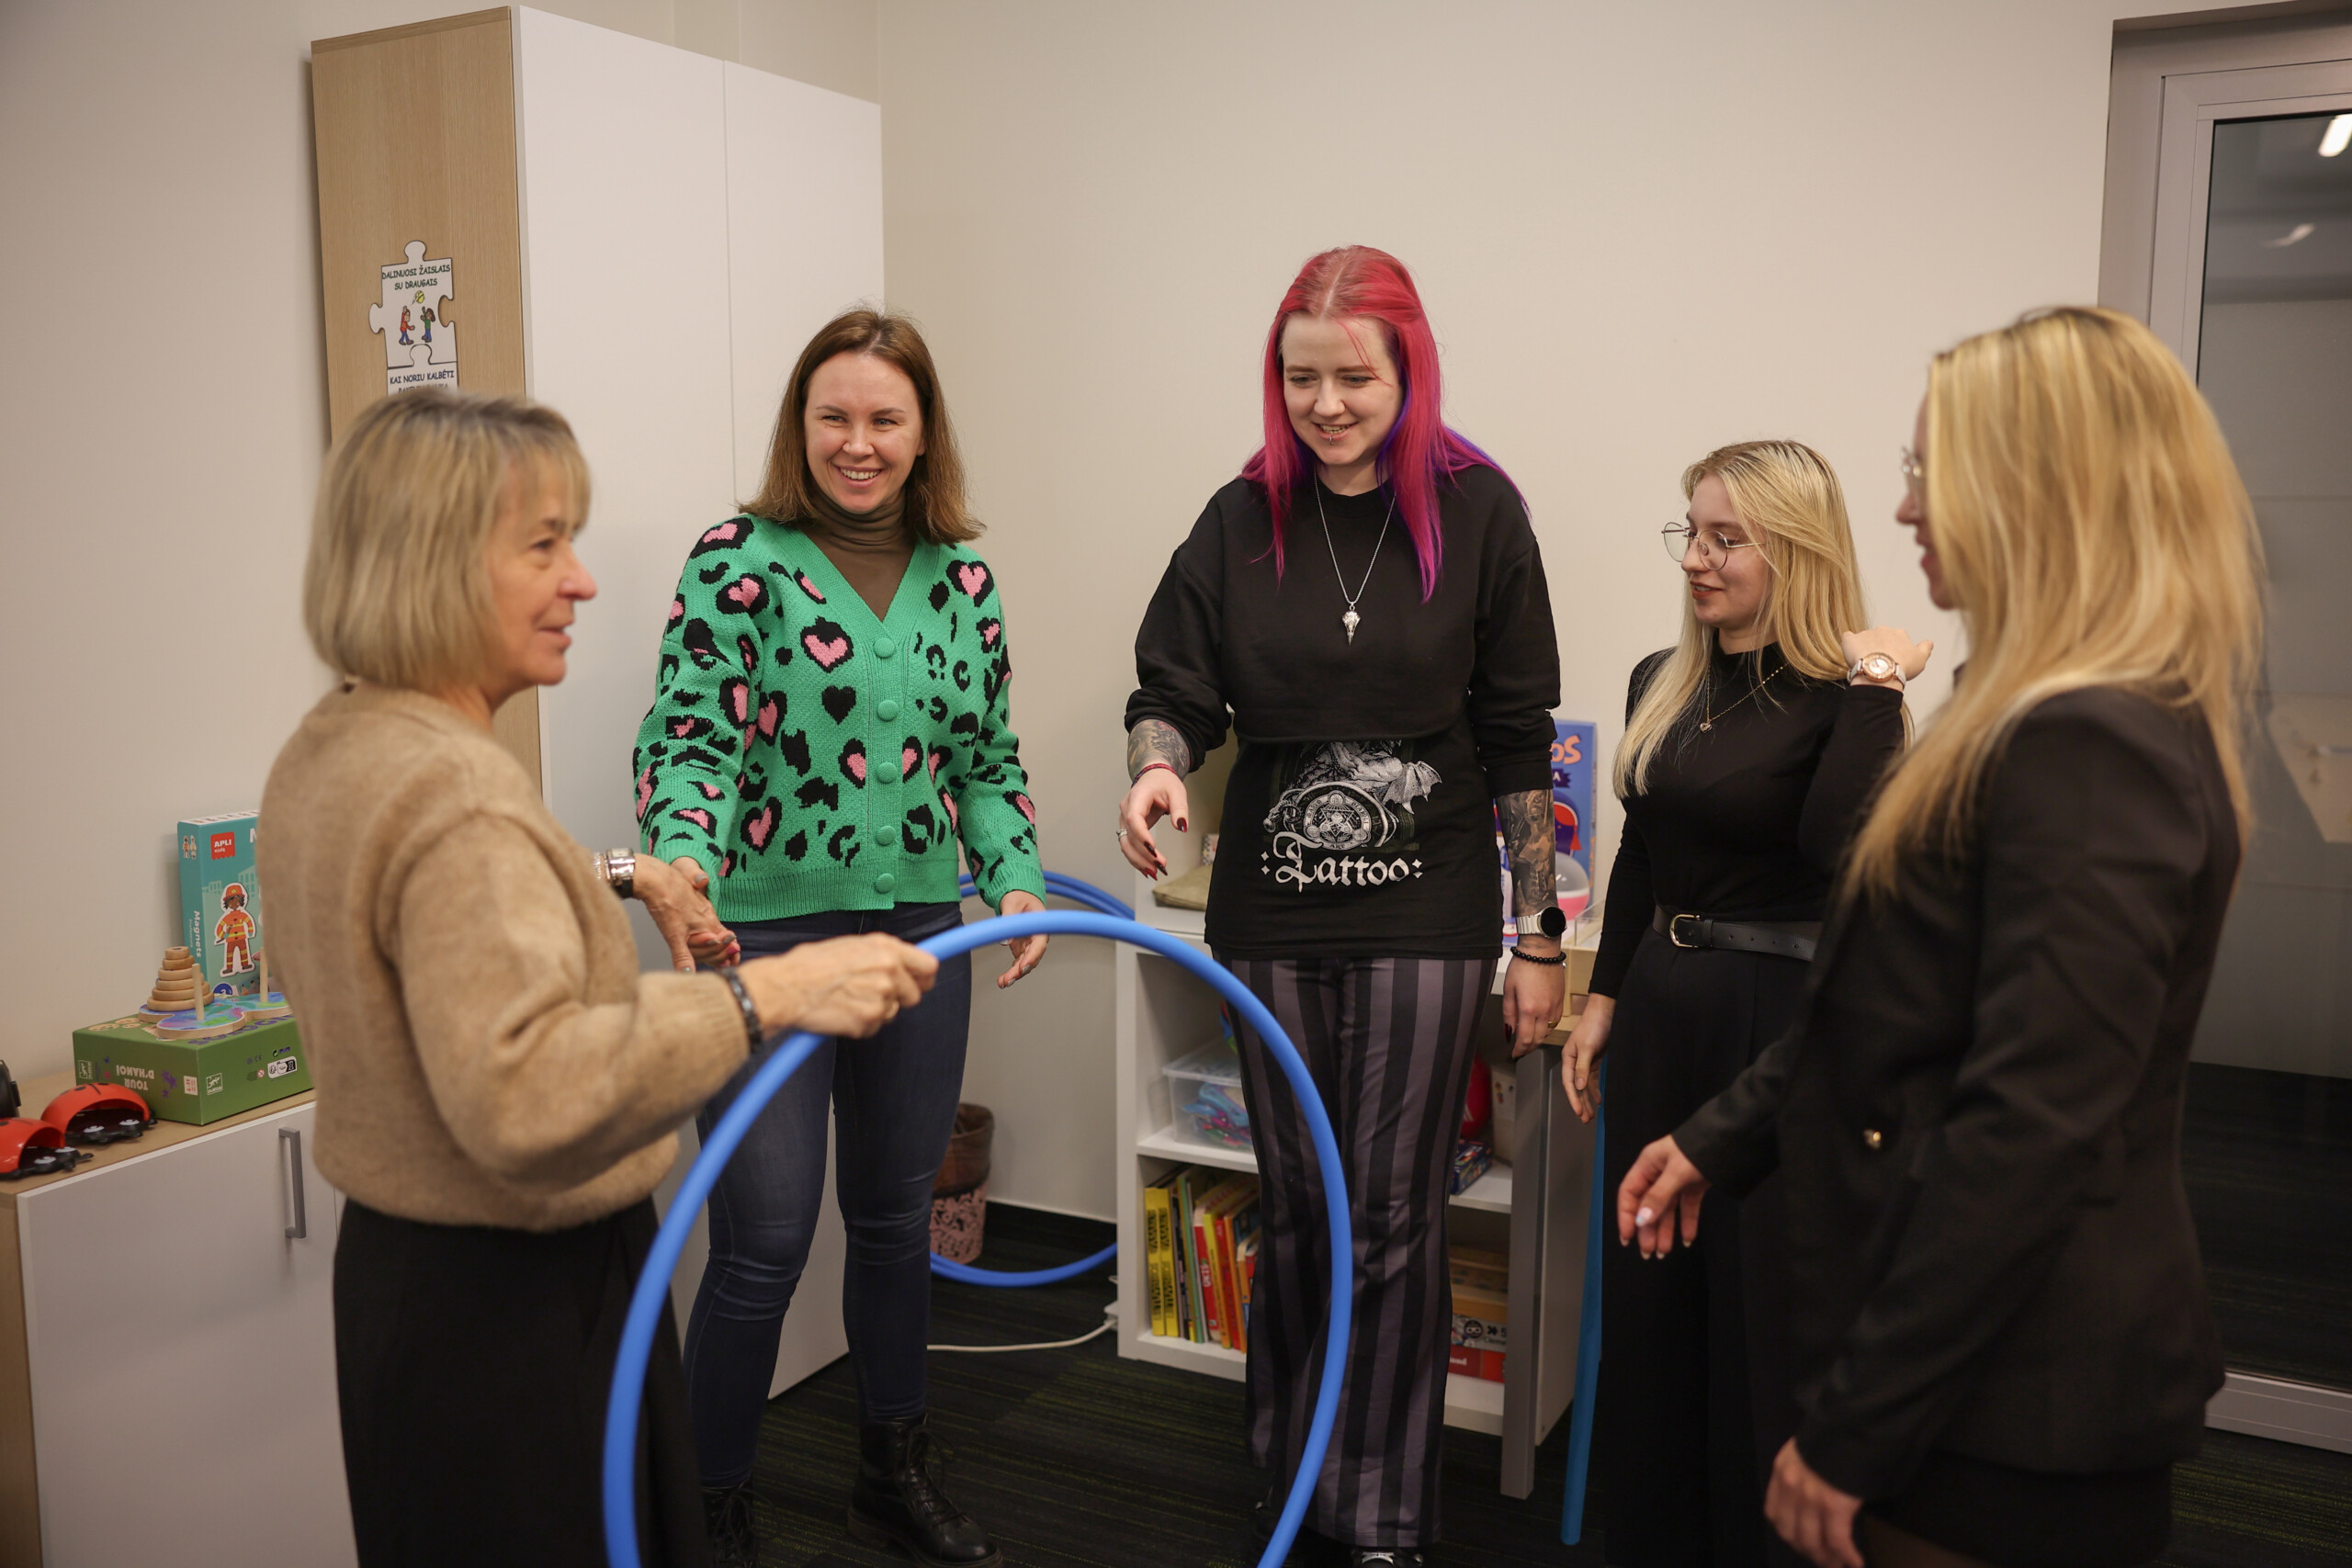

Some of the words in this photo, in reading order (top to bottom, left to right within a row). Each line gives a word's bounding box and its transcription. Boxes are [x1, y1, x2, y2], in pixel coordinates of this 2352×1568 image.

[381, 268, 417, 279] DALINUOSI
[419, 265, 450, 276] ŽAISLAIS
[394, 282, 403, 290] SU
[405, 278, 437, 289] DRAUGAIS
[390, 376, 401, 385] KAI
[403, 373, 424, 383] NORIU
[427, 369, 454, 380] KALBĖTI
[214, 839, 232, 848] APLI
[193, 910, 201, 958] Magnets
[124, 1077, 149, 1090] TOUR
